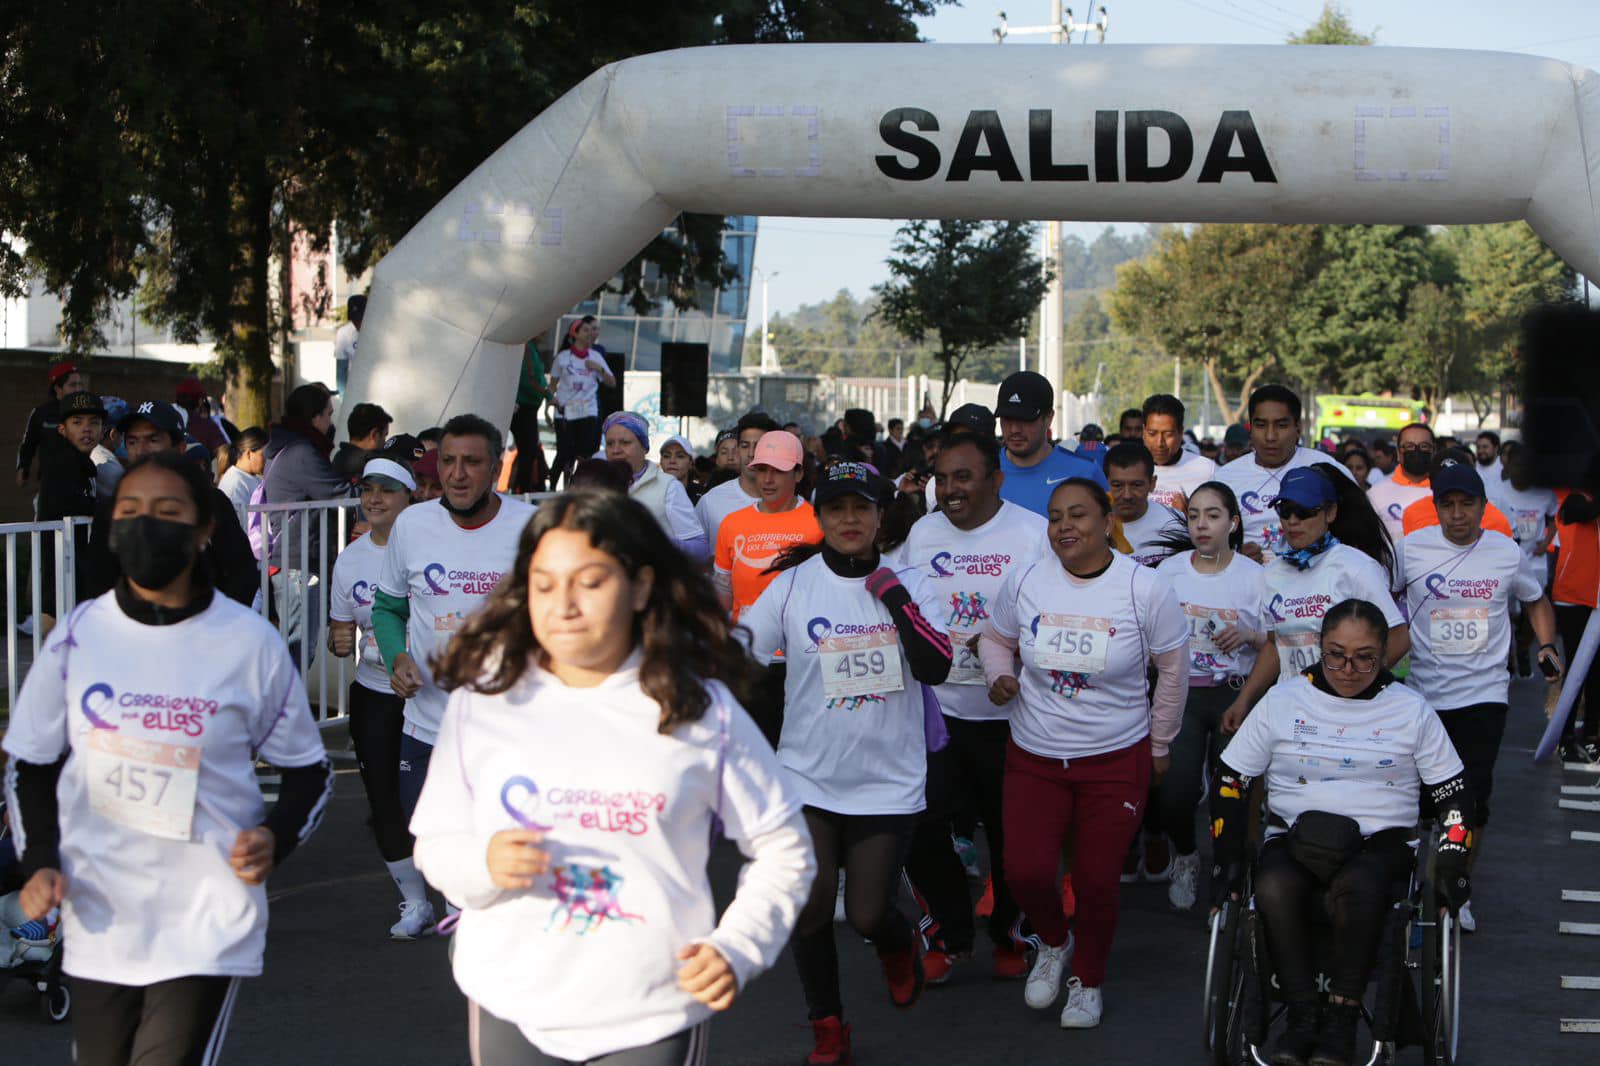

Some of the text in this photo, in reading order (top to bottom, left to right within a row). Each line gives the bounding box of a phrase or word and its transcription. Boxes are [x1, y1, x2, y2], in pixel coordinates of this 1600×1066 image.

[874, 106, 1278, 185] SALIDA
[1047, 629, 1094, 655] 456
[1440, 621, 1478, 641] 396
[836, 650, 886, 678] 459
[104, 762, 173, 807] 457
